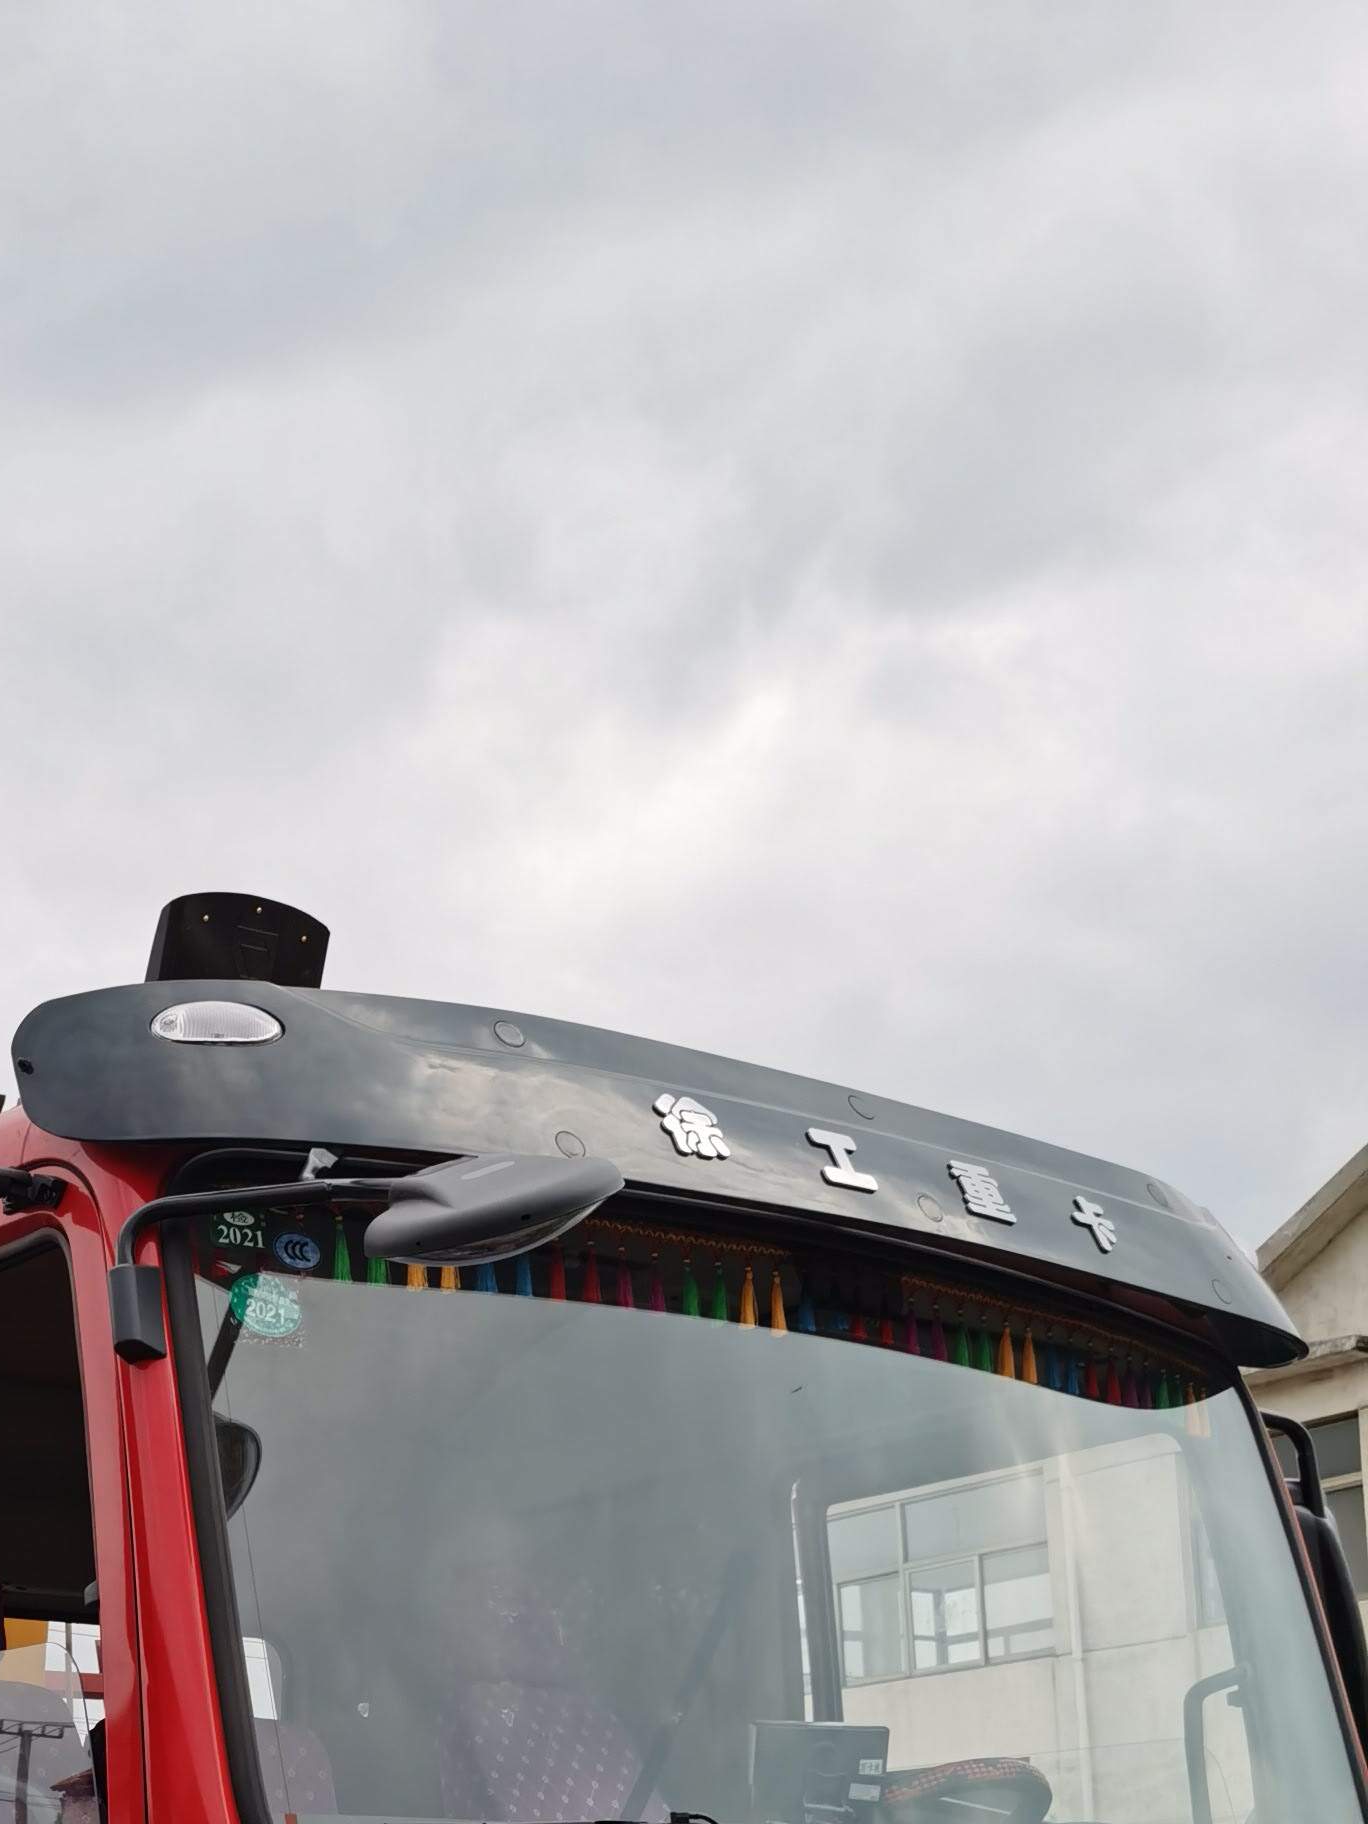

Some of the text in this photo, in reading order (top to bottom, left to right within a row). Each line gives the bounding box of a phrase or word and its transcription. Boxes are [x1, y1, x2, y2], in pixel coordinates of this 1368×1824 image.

[652, 1092, 1119, 1254] 徐工重卡
[217, 1225, 266, 1249] 2021
[245, 1298, 286, 1325] 2021
